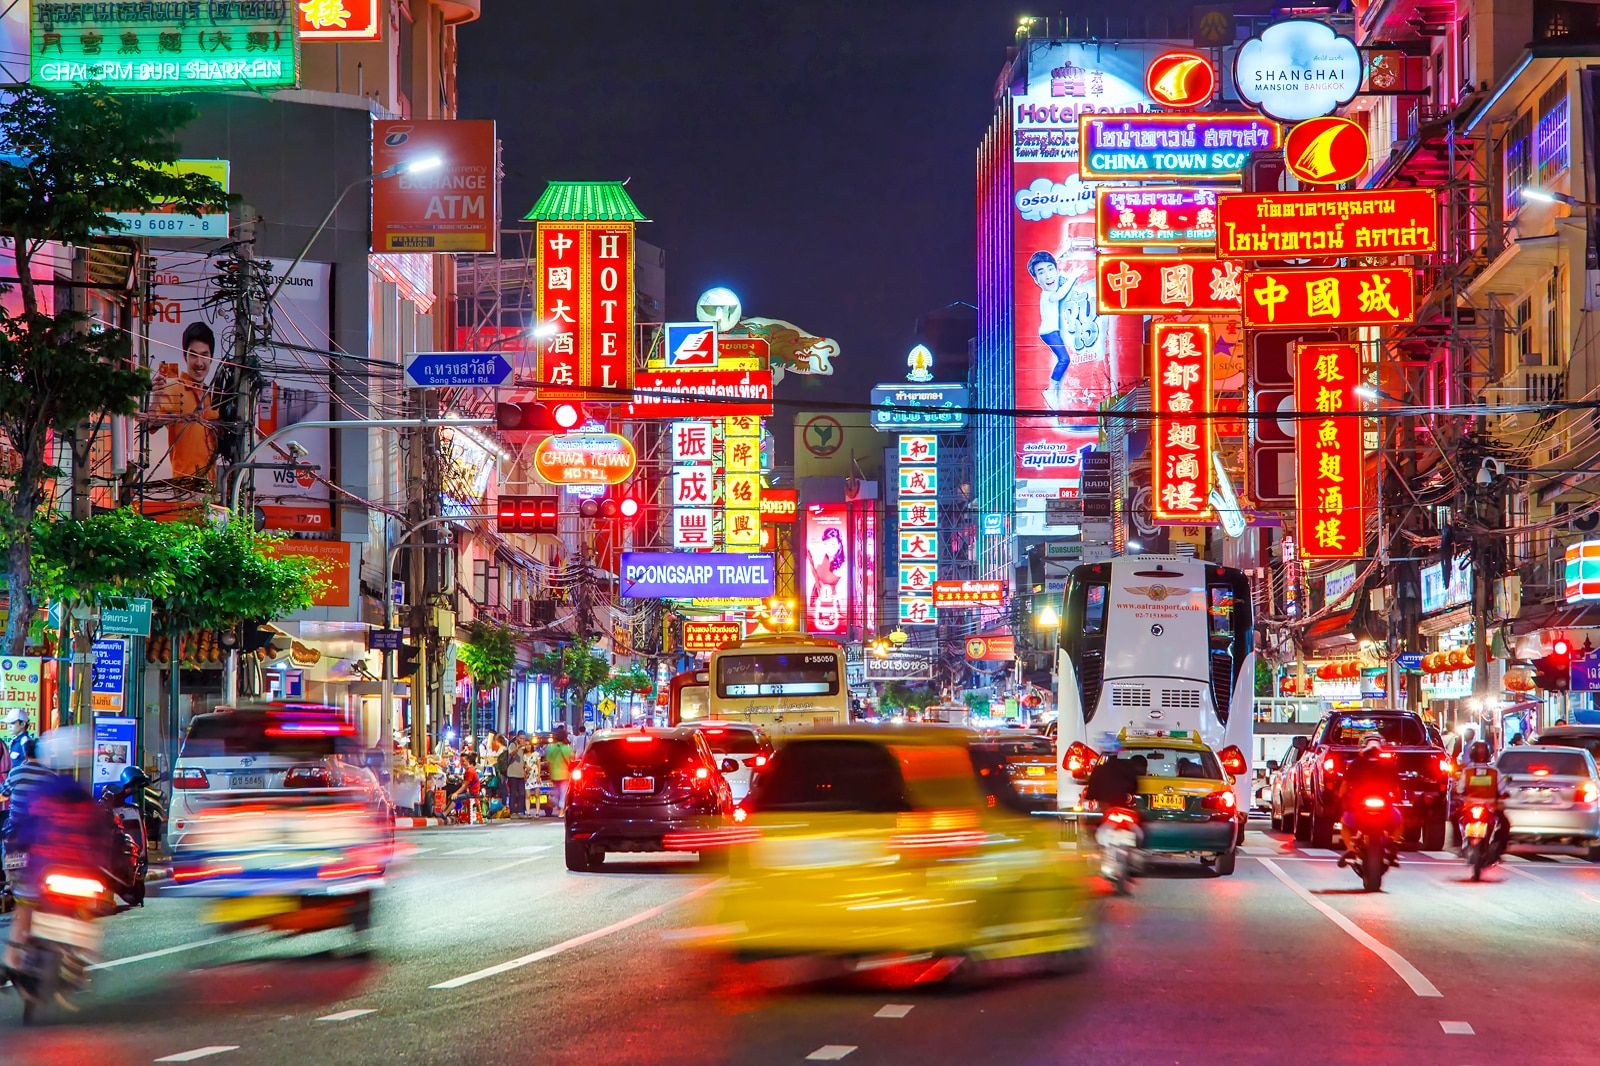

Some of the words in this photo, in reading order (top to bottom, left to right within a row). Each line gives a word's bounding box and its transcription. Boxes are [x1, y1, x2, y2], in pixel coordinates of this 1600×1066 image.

[139, 63, 180, 81] BURI
[1255, 69, 1345, 81] SHANGHAI
[1304, 83, 1345, 91] BANGKOK
[1017, 103, 1078, 123] Hotel
[1092, 121, 1196, 148] ไชน่าทาวน์
[1203, 122, 1269, 147] สกาล่า
[1092, 154, 1149, 169] CHINA
[1152, 153, 1208, 169] TOWN
[399, 175, 487, 190] EXCHANGE
[424, 195, 485, 220] ATM
[1224, 222, 1345, 251] ไชน่าทาวน์
[1355, 218, 1430, 248] สกาล่า
[1107, 261, 1243, 309] 中國城
[1253, 273, 1400, 323] 中國城
[547, 232, 577, 386] 中國大酒店
[598, 235, 620, 388] HOTEL
[424, 355, 499, 376] ถ.ทรงสวัสดิ์
[429, 376, 449, 386] Song
[452, 375, 476, 385] Sawat
[477, 376, 490, 385] Rd.
[1161, 331, 1204, 511] 銀都魚翅酒樓
[1023, 453, 1076, 468] สมุนไพร
[1313, 353, 1346, 550] 銀都魚翅酒樓
[678, 427, 708, 544] 振成豐
[1084, 480, 1109, 488] RADO
[909, 441, 929, 619] 和成興大金行
[626, 565, 714, 585] ROONGSARP
[716, 565, 769, 584] TRAVEL
[5, 673, 26, 682] true
